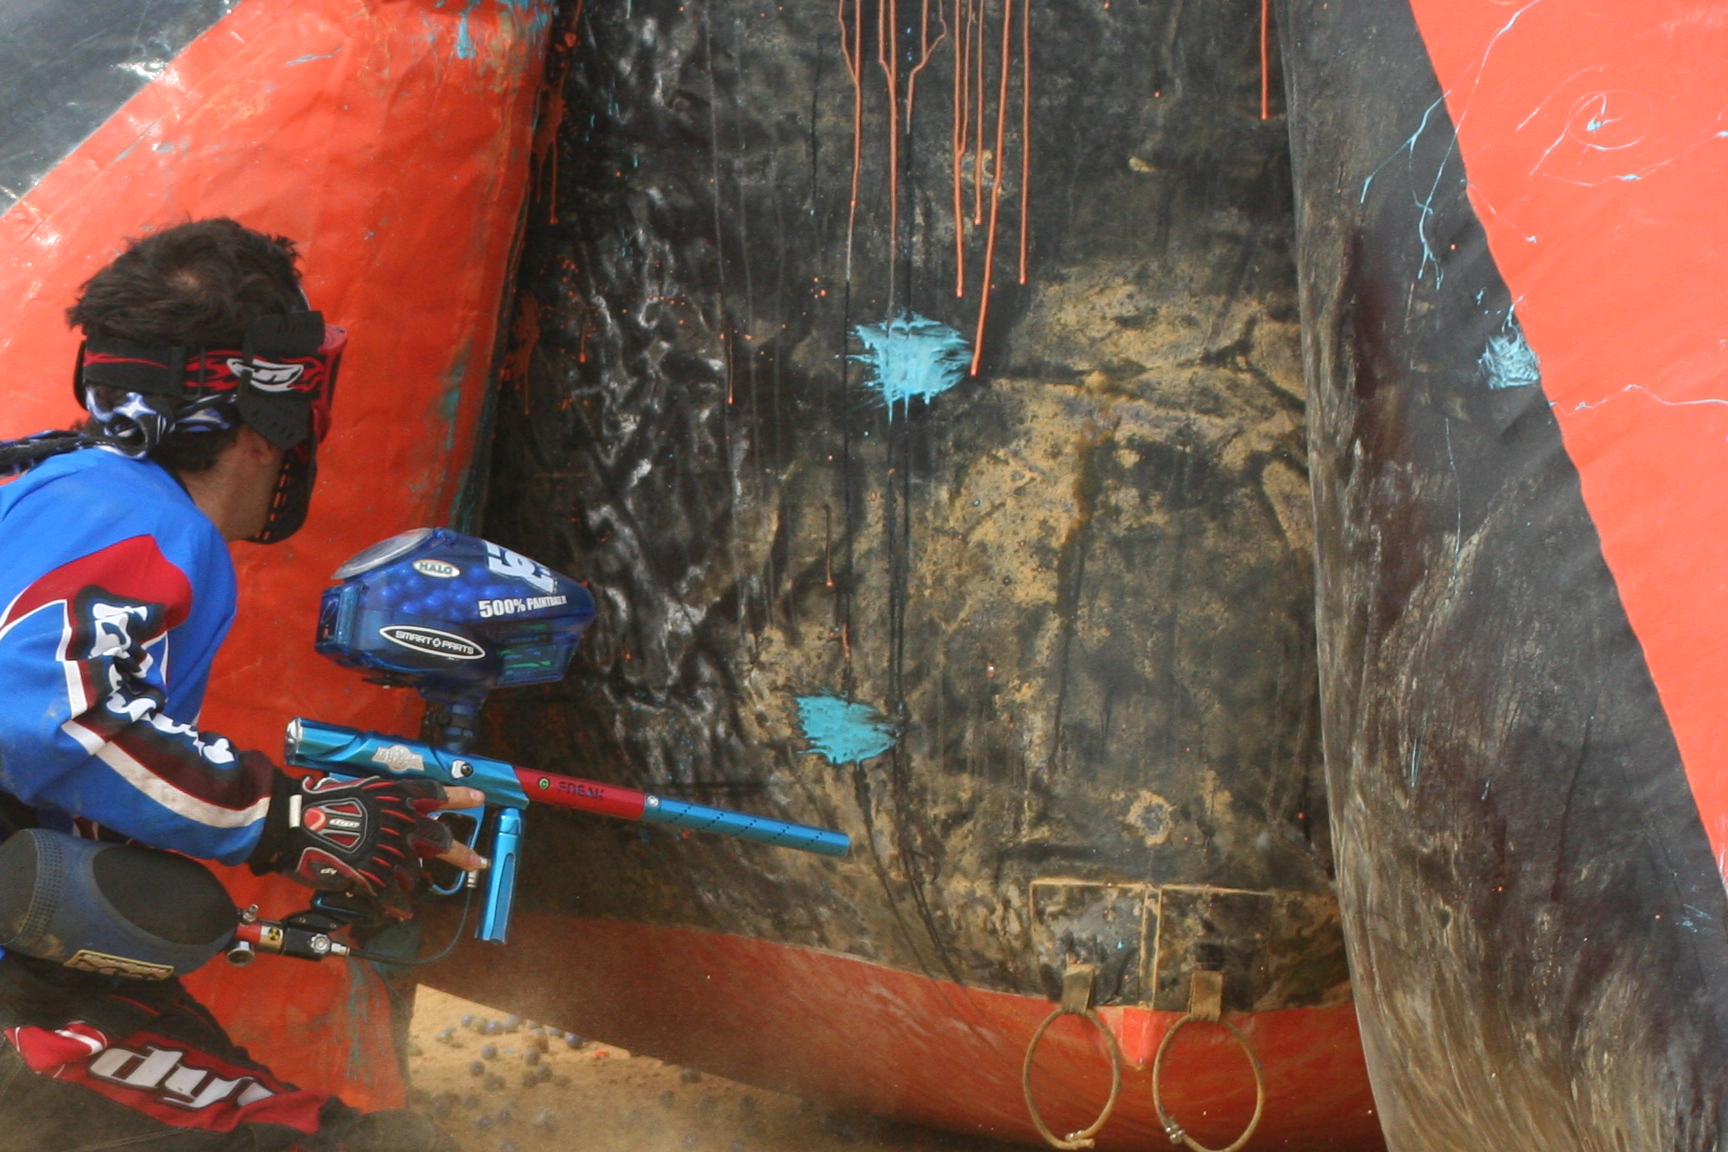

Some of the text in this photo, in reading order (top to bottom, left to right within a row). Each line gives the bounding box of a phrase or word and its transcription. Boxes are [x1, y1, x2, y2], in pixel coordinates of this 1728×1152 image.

[419, 561, 453, 576] HALO
[478, 600, 526, 618] 500%
[395, 630, 474, 655] SMART PARTS
